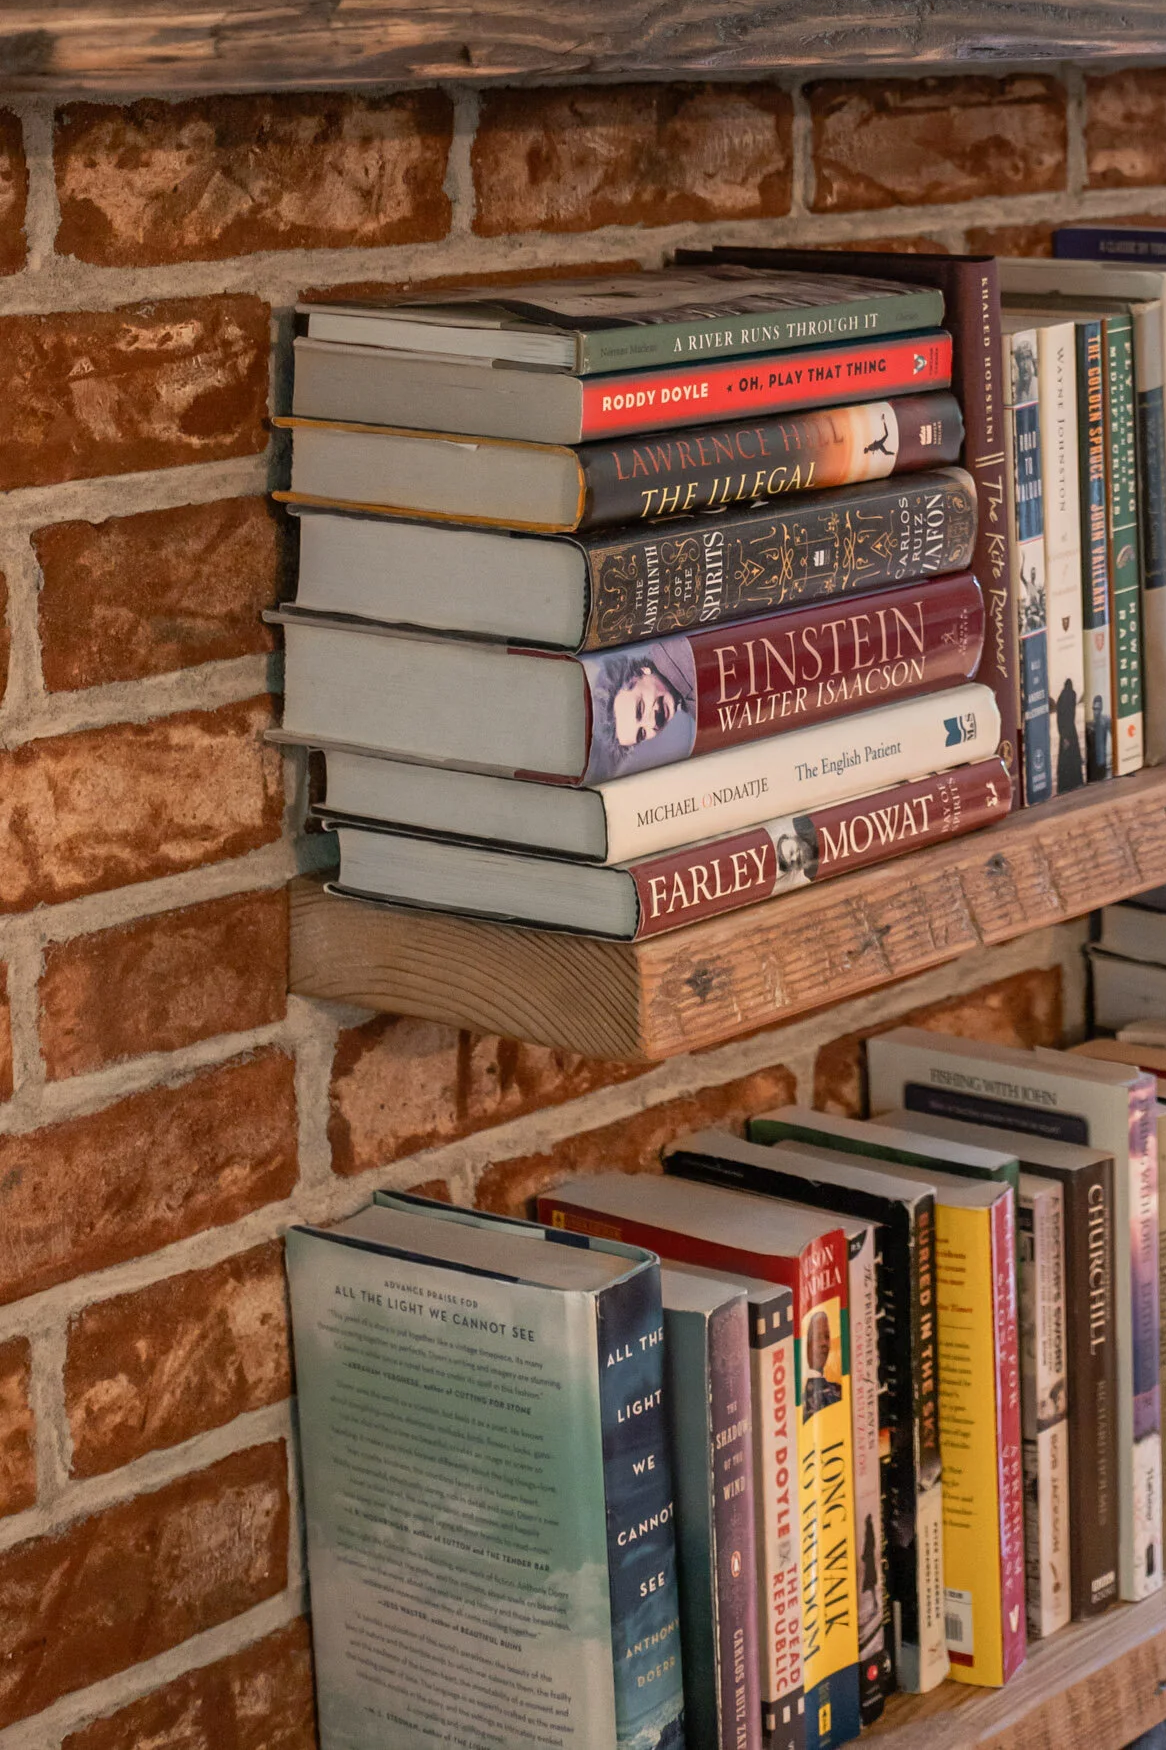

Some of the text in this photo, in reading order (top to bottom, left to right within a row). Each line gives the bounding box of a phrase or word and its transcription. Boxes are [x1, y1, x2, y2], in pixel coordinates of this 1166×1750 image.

[672, 312, 879, 352] A RIVER RUNS THROUGH IT
[602, 358, 887, 412] RODDY DOYLE OH, PLAY THAT THING
[611, 415, 846, 482] LAWRENCE HILL
[640, 461, 817, 519] THE ILLEGAL
[981, 276, 1009, 679] KHALED HOSSEINI The Kite Runner
[1087, 335, 1105, 614] THE GOLDEN SPRUCE JOHN VAILLANT
[894, 496, 911, 581] CARLOS
[919, 492, 946, 575] ZAFÓN
[639, 545, 661, 637] LABYRINTH
[698, 530, 726, 623] SPIRITS
[712, 601, 927, 705] EINSTEIN
[716, 656, 927, 731] WALTER ISAACSON
[635, 742, 901, 827] MICHAEL ONDAATJE The English Patient
[648, 793, 936, 919] FARLEY MOWAT
[383, 1281, 424, 1295] ADVANCE
[427, 1290, 457, 1304] PRAISE
[1088, 1183, 1106, 1355] CHURCHILL
[335, 1285, 535, 1342] ALL THE LIGHT WE CANNOT SEE
[606, 1326, 665, 1369] ALL THE
[919, 1210, 934, 1448] BURIED IN THE SKY
[616, 1389, 663, 1425] LIGHT
[772, 1347, 791, 1538] RODDY DOYLE
[632, 1454, 656, 1477] WE
[616, 1501, 675, 1548] CANNOT
[802, 1444, 821, 1664] TO FREEDOM
[820, 1437, 850, 1638] LONG WALK
[638, 1571, 667, 1599] SEE
[787, 1563, 800, 1685] THE DEAD
[624, 1618, 681, 1661] ANTHONY
[636, 1656, 677, 1689] DOERR
[773, 1571, 789, 1693] REPUBLIC
